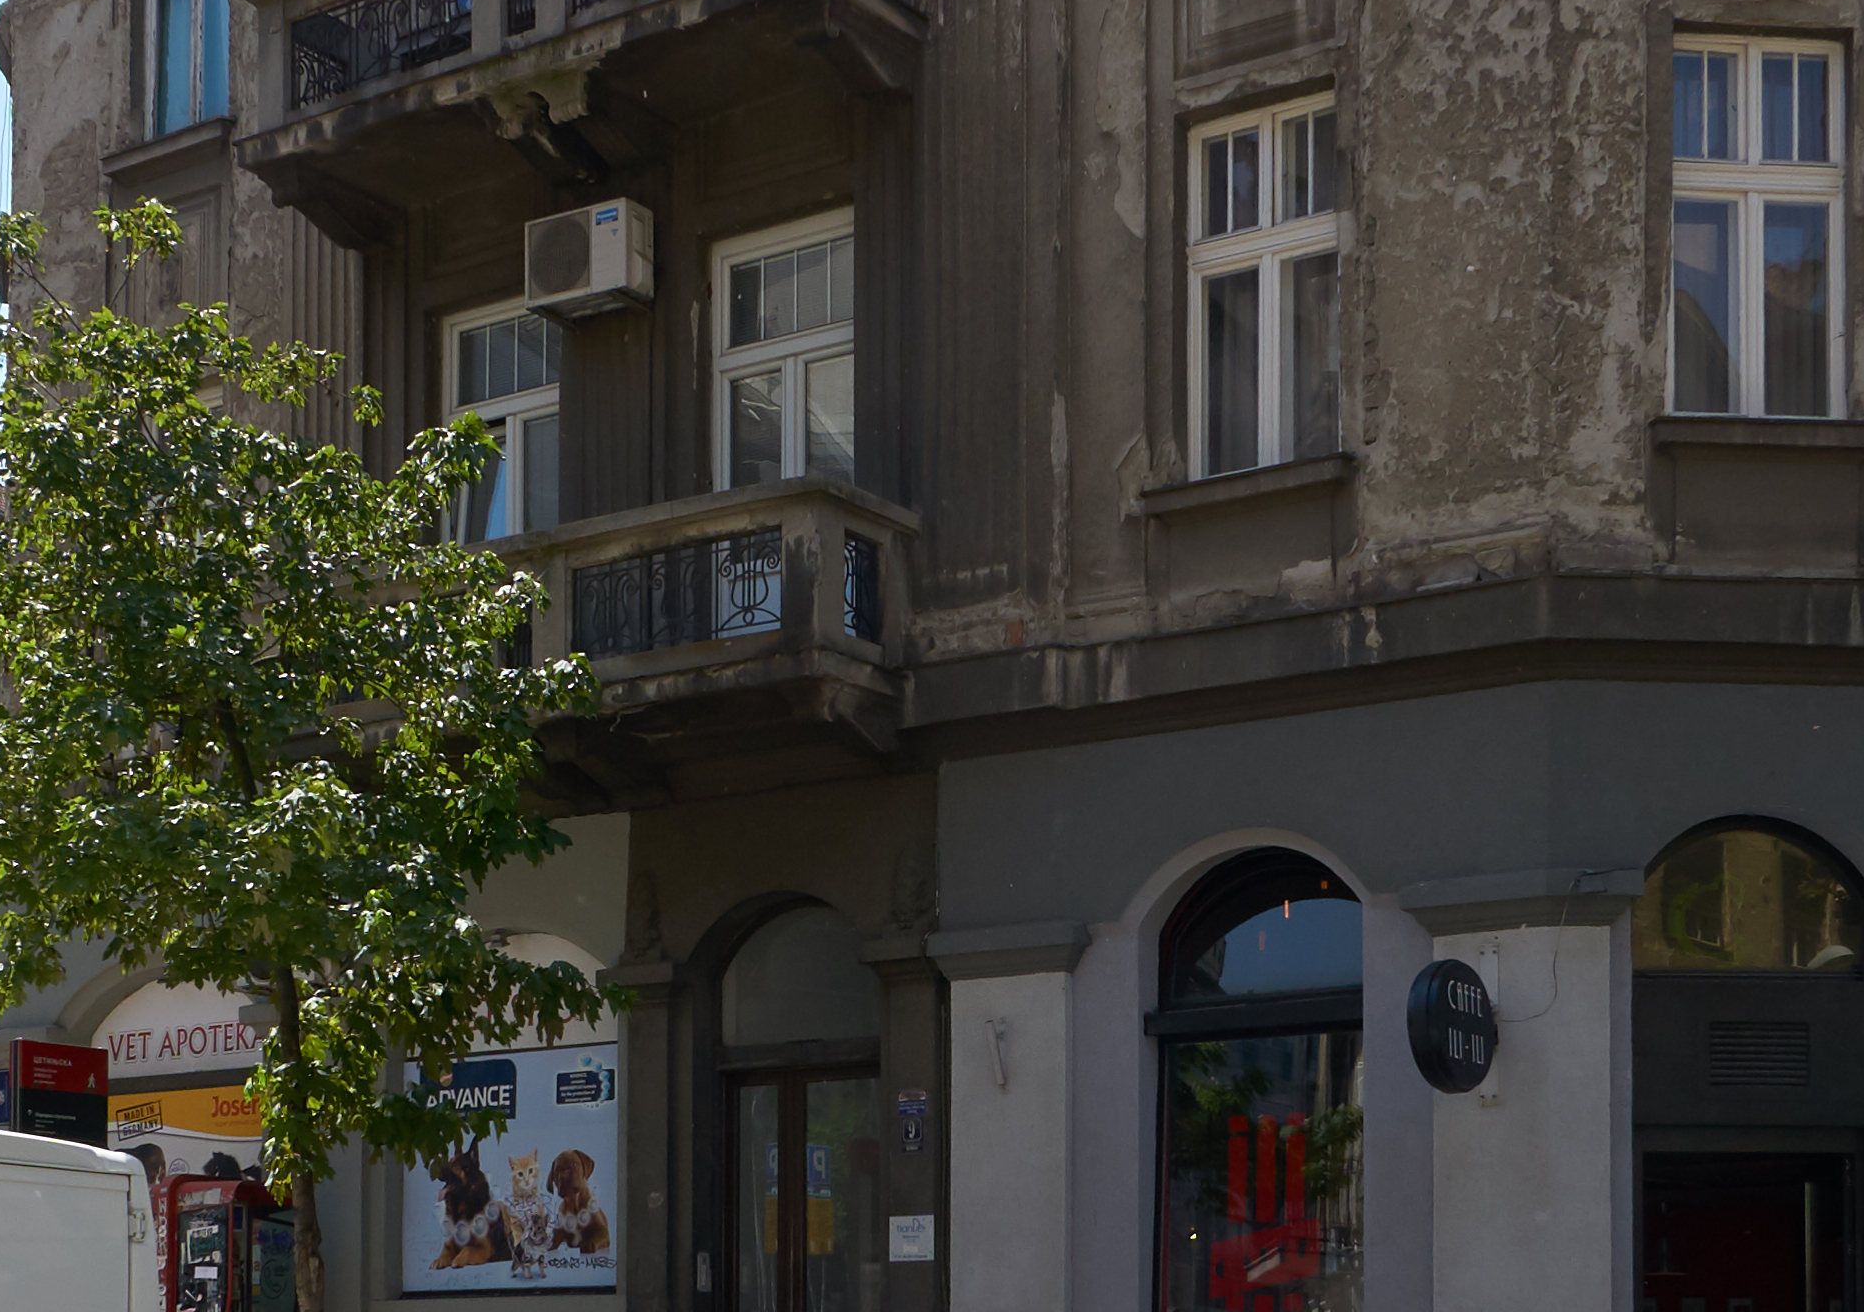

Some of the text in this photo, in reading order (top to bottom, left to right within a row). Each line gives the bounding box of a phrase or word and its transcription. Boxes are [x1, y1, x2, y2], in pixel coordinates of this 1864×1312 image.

[1447, 979, 1482, 1018] CAFFE
[108, 1030, 152, 1062] VET
[123, 1104, 156, 1121] MADE IN
[211, 1095, 261, 1118] Joser
[122, 1118, 159, 1136] GERMANY
[908, 1120, 916, 1139] 9
